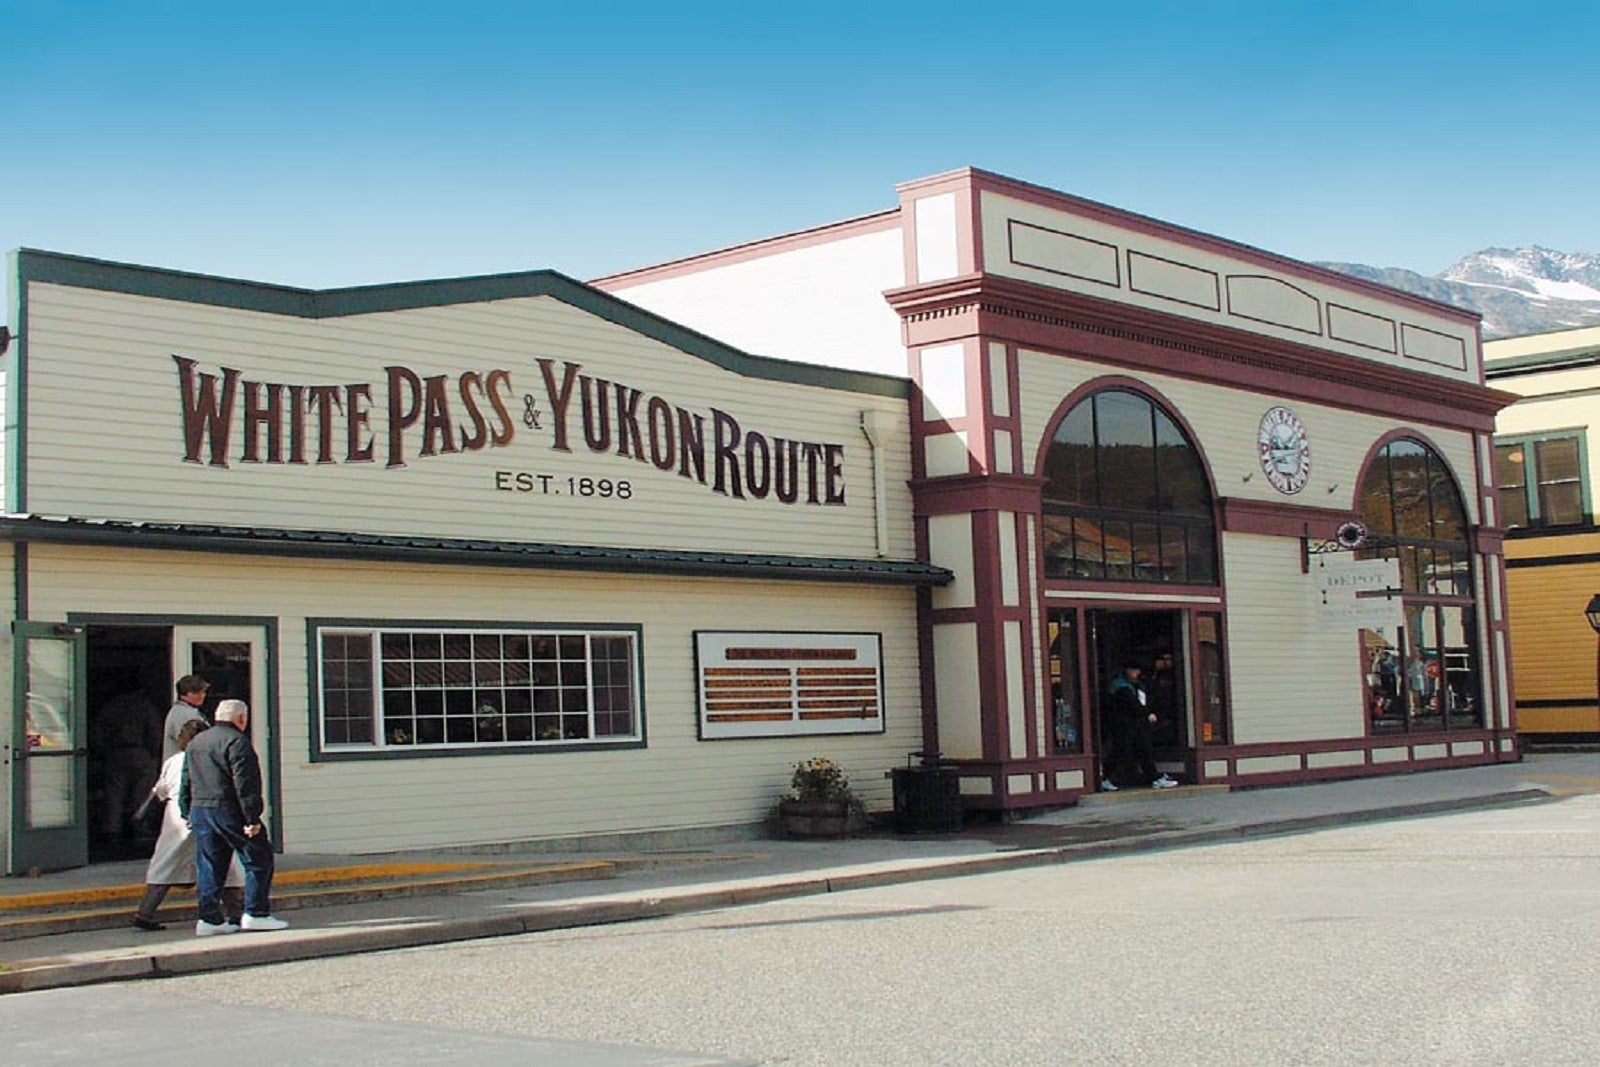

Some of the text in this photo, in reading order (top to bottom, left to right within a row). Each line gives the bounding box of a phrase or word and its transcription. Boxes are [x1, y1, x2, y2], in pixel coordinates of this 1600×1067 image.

[172, 354, 847, 506] WHITE PASS & YUKON ROUTE
